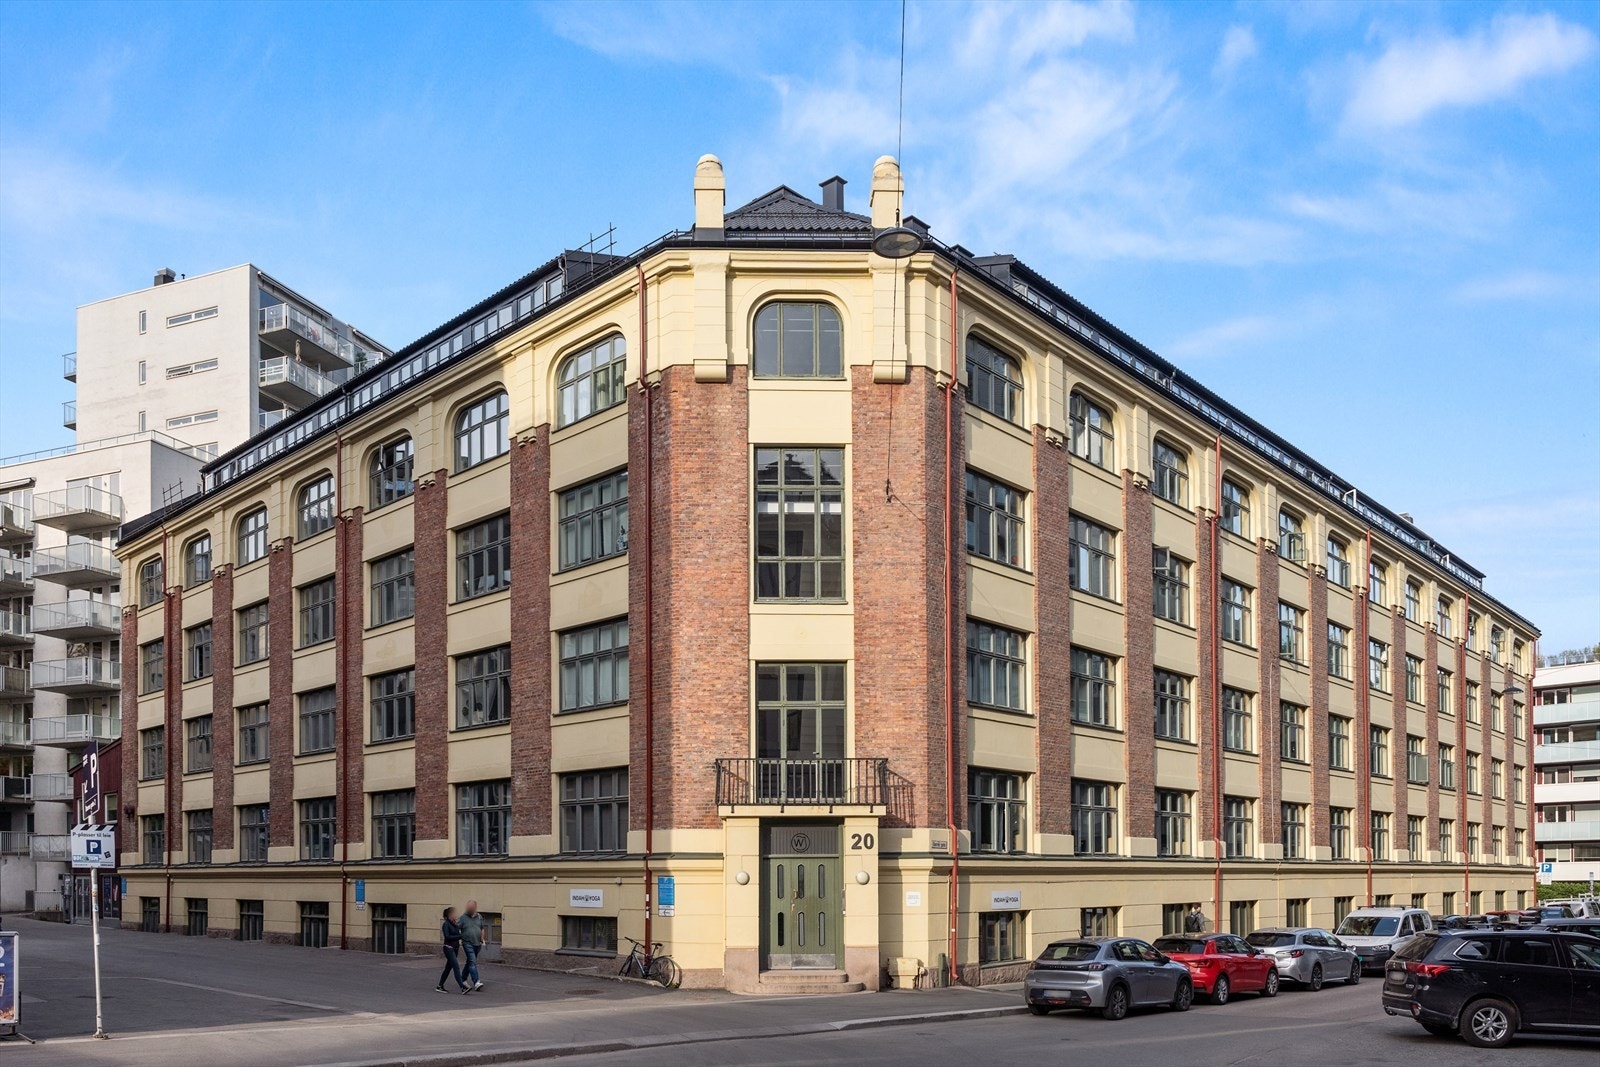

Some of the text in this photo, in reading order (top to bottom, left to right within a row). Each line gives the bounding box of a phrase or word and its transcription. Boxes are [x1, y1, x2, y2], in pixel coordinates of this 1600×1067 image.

[90, 752, 97, 788] P
[90, 841, 99, 853] P
[851, 833, 874, 850] 20
[1543, 864, 1550, 872] P
